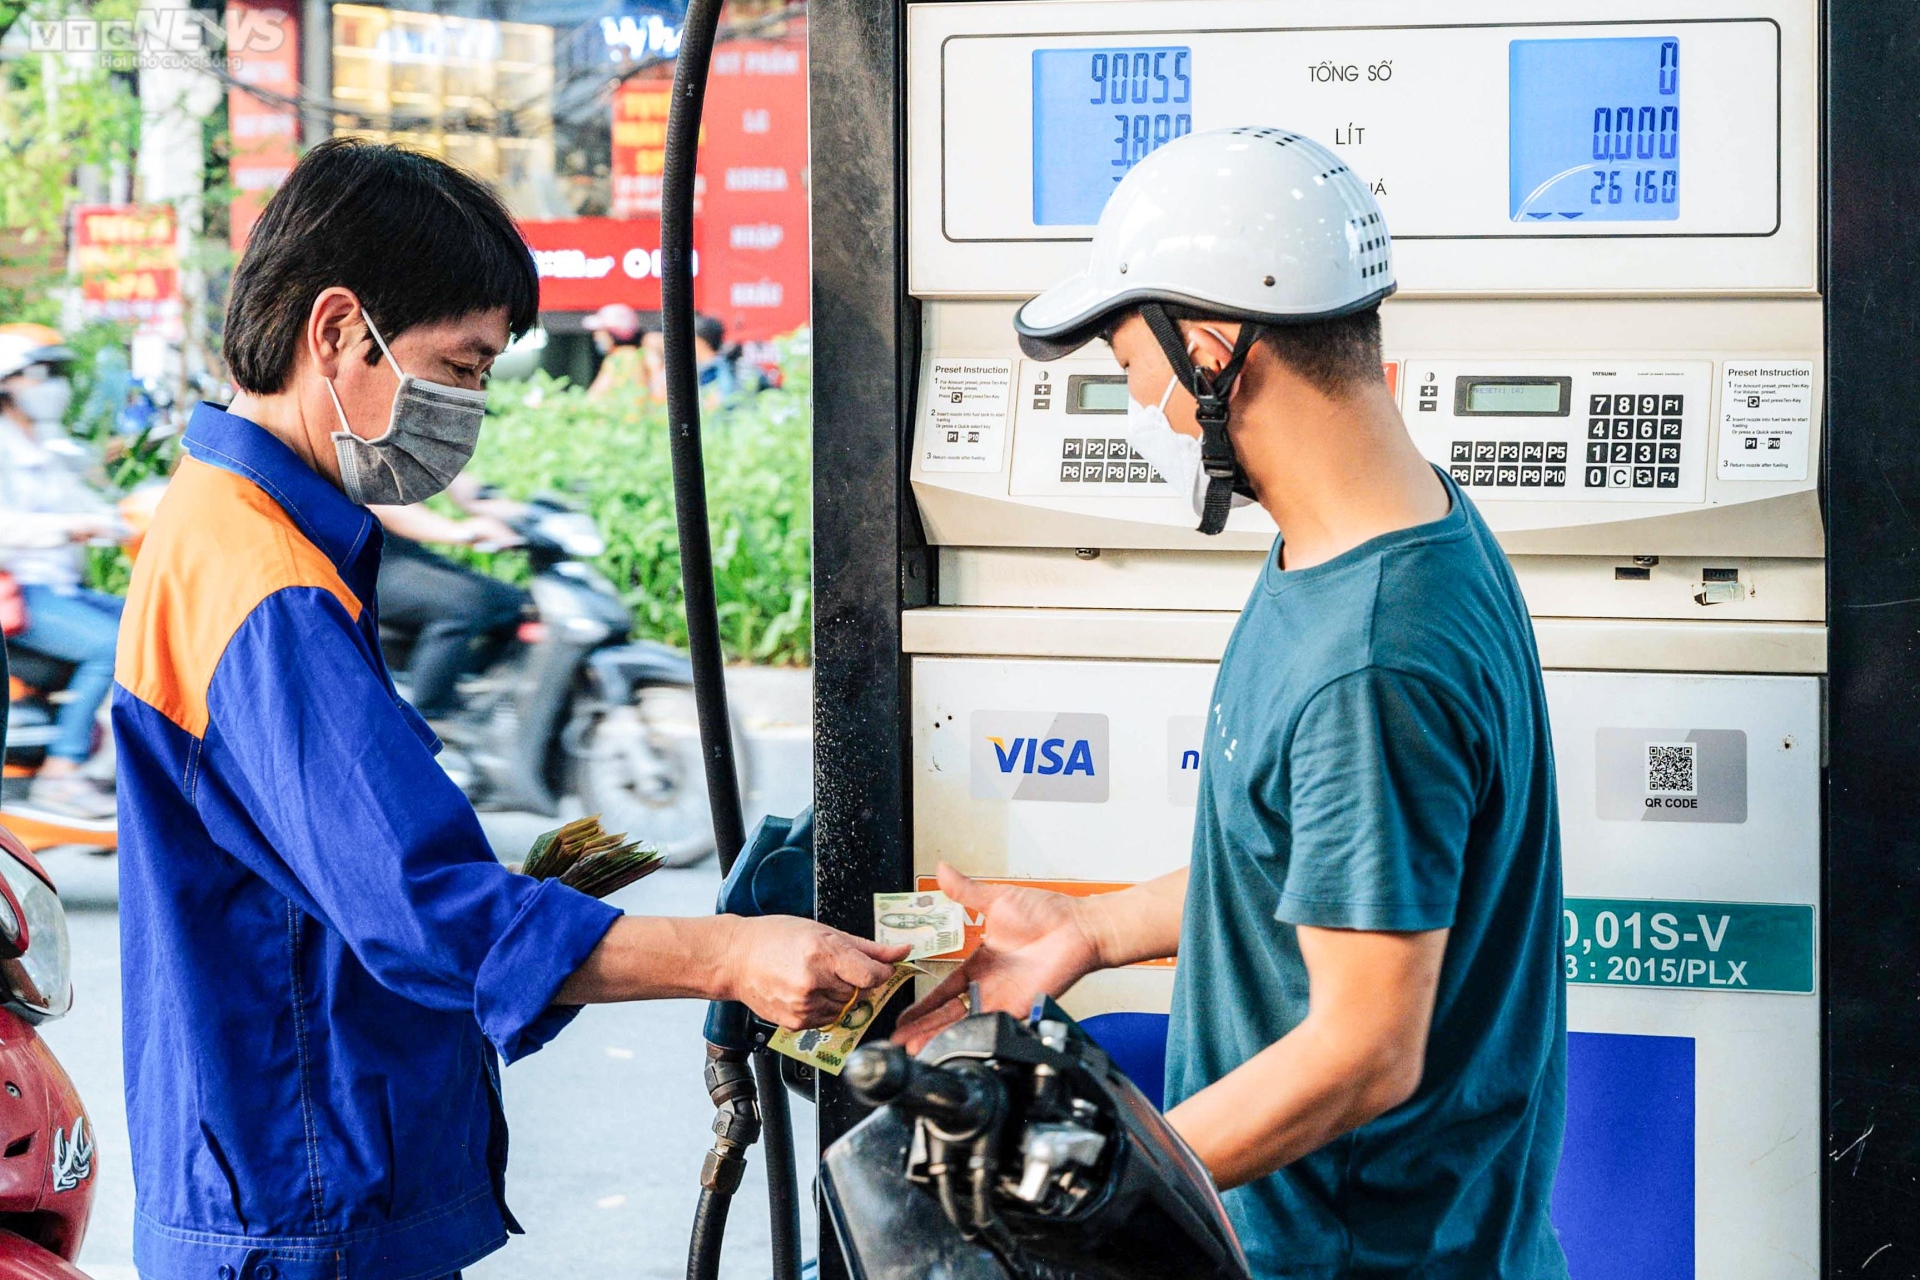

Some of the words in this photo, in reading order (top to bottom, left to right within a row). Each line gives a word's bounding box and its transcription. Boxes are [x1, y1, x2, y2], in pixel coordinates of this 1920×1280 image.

[1308, 60, 1359, 82] TỔNG
[1367, 60, 1393, 82] SỐ
[1659, 42, 1678, 95] 0
[1090, 52, 1188, 105] 90055
[1335, 122, 1366, 145] LÍT
[1592, 106, 1678, 163] 0,000
[1590, 170, 1677, 205] 26160
[1595, 397, 1606, 412] 7
[1618, 397, 1630, 413] 8
[1642, 397, 1654, 413] 9
[1665, 400, 1678, 410] F1
[1593, 421, 1604, 437] 4
[1617, 422, 1628, 437] 5
[1641, 422, 1652, 437] 6
[1664, 424, 1678, 434] F2
[1065, 443, 1079, 454] P1
[1087, 443, 1104, 455] P2
[1109, 443, 1126, 455] P3
[1453, 446, 1469, 457] P1
[1477, 446, 1494, 458] P2
[1500, 446, 1518, 458] P3
[1524, 446, 1541, 458] P4
[1548, 447, 1566, 458] P5
[1593, 446, 1600, 461] 1
[1616, 446, 1627, 461] 2
[1640, 446, 1650, 461] 3
[1662, 448, 1677, 459] F3
[1062, 467, 1079, 478] P6
[1085, 467, 1102, 478] P7
[1108, 467, 1124, 478] P8
[1130, 467, 1146, 478] P9
[1452, 469, 1469, 481] P6
[1475, 470, 1493, 481] P7
[1499, 470, 1516, 481] P8
[1522, 470, 1540, 482] P9
[1545, 471, 1565, 483] P10
[1590, 469, 1601, 485] 0
[1614, 470, 1626, 485] C
[1661, 472, 1675, 482] F4
[985, 736, 1095, 776] VISA
[1645, 798, 1662, 808] QR
[1665, 798, 1698, 808] CODE
[1607, 956, 1748, 985] 2015/PLX
